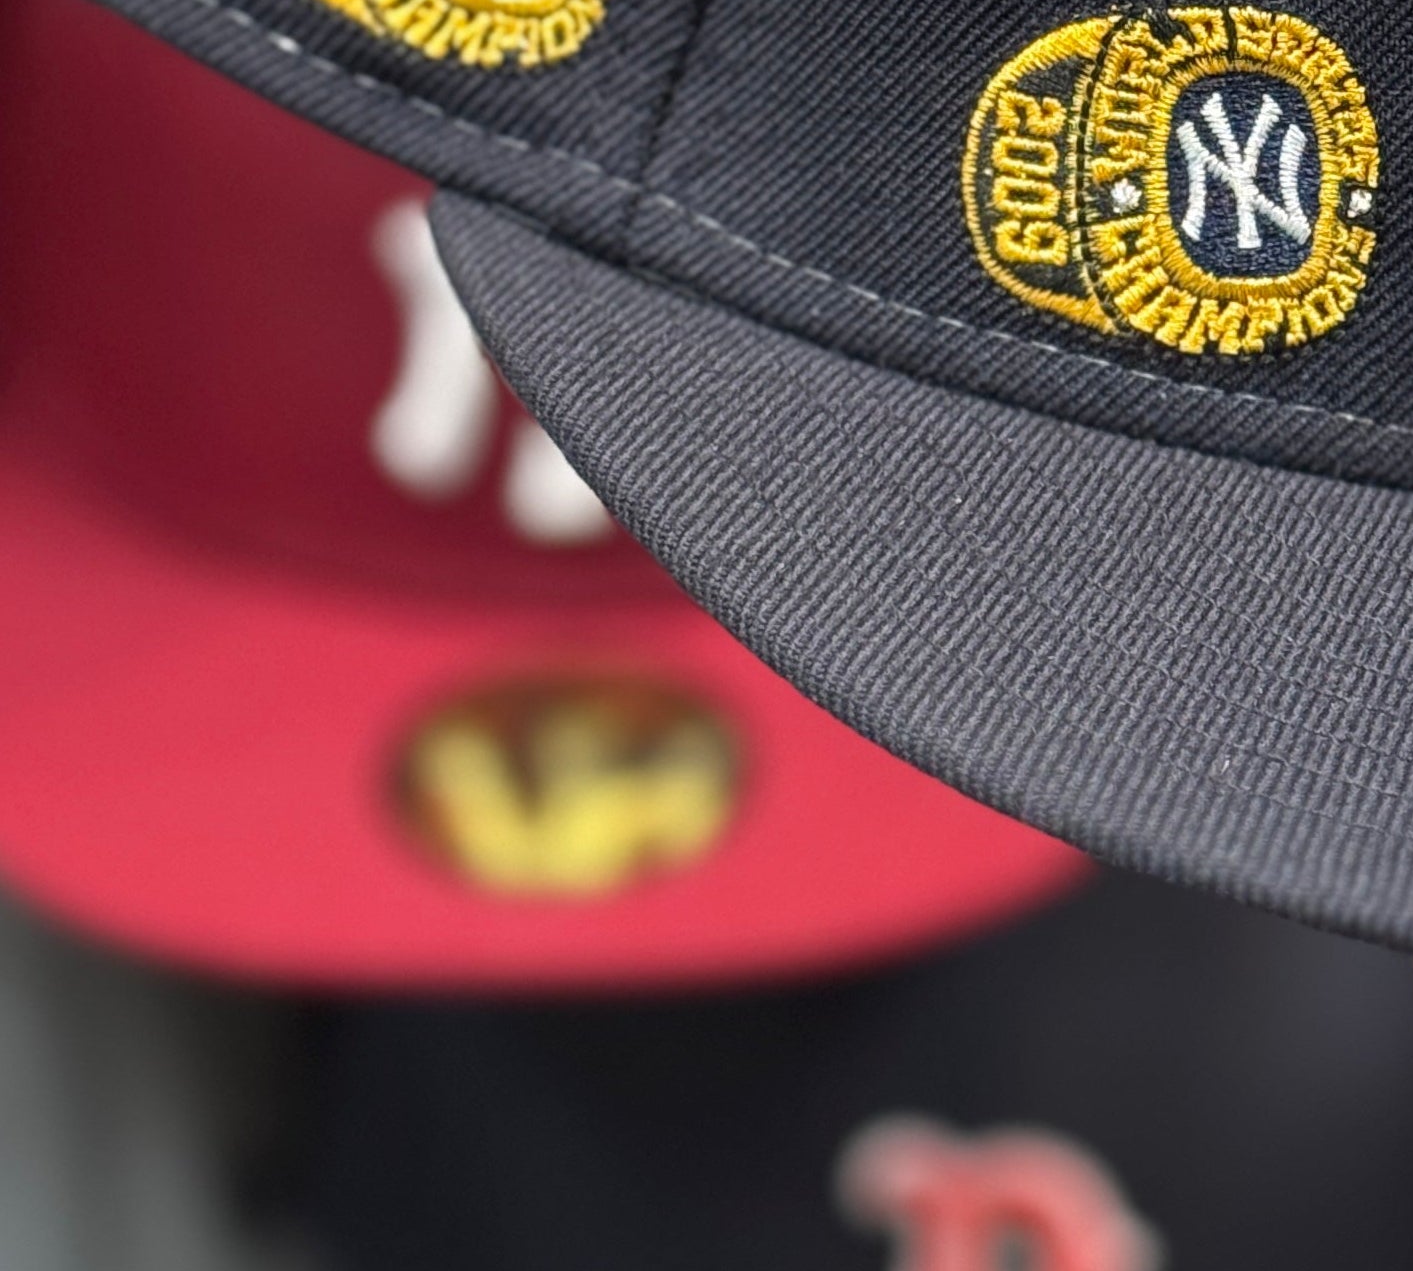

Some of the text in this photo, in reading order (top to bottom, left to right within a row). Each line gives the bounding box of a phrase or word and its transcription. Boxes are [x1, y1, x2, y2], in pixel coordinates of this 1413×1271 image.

[991, 88, 1070, 267] 2009
[1176, 91, 1312, 250] NY
[1091, 214, 1378, 355] CHAMPIONS
